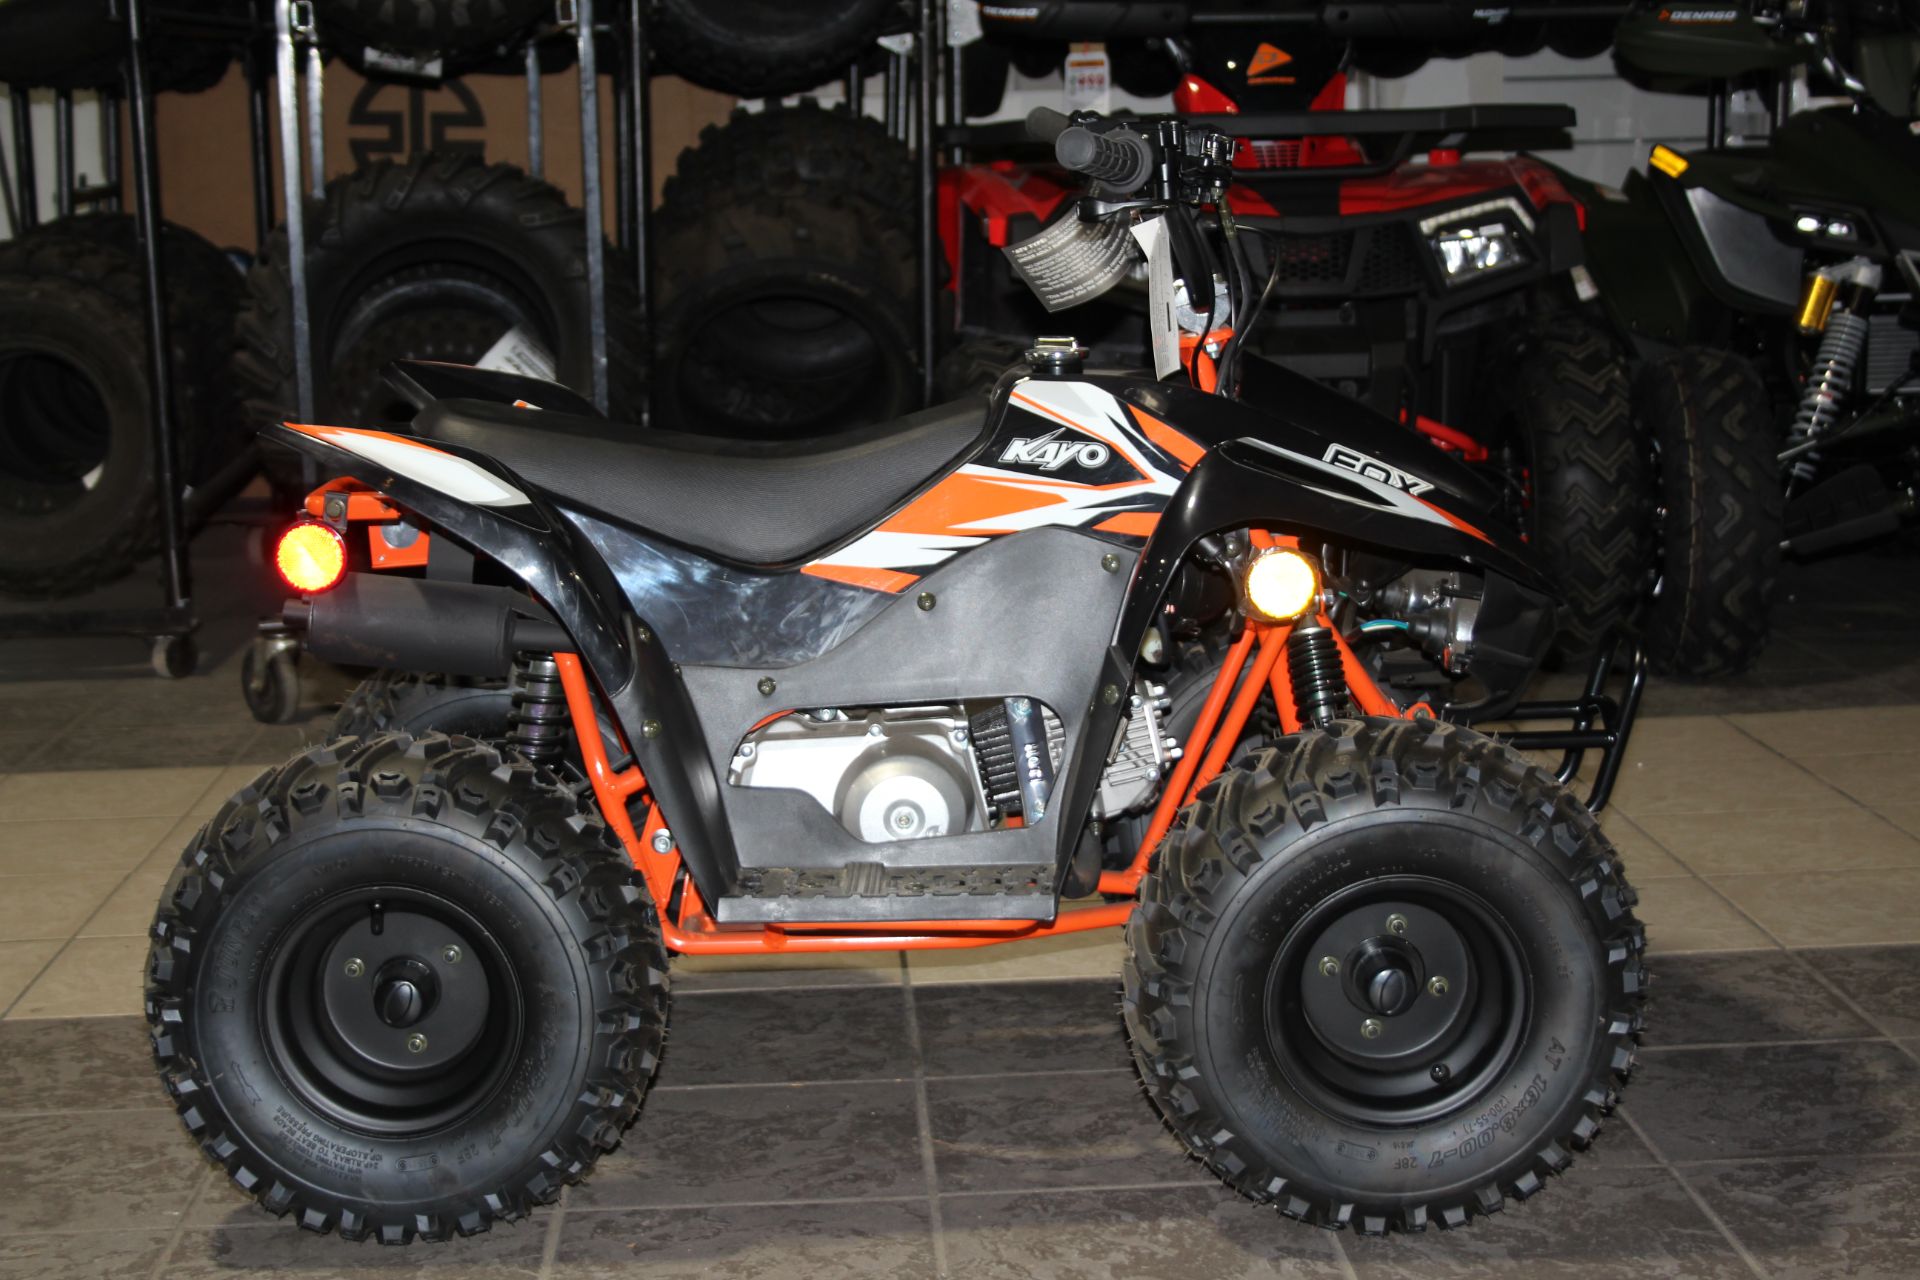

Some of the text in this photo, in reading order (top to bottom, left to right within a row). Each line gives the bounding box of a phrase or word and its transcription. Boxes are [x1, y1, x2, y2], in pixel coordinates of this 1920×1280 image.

[1669, 10, 1738, 21] DENAGO
[998, 426, 1110, 471] KAYO
[1545, 1036, 1566, 1072] AT
